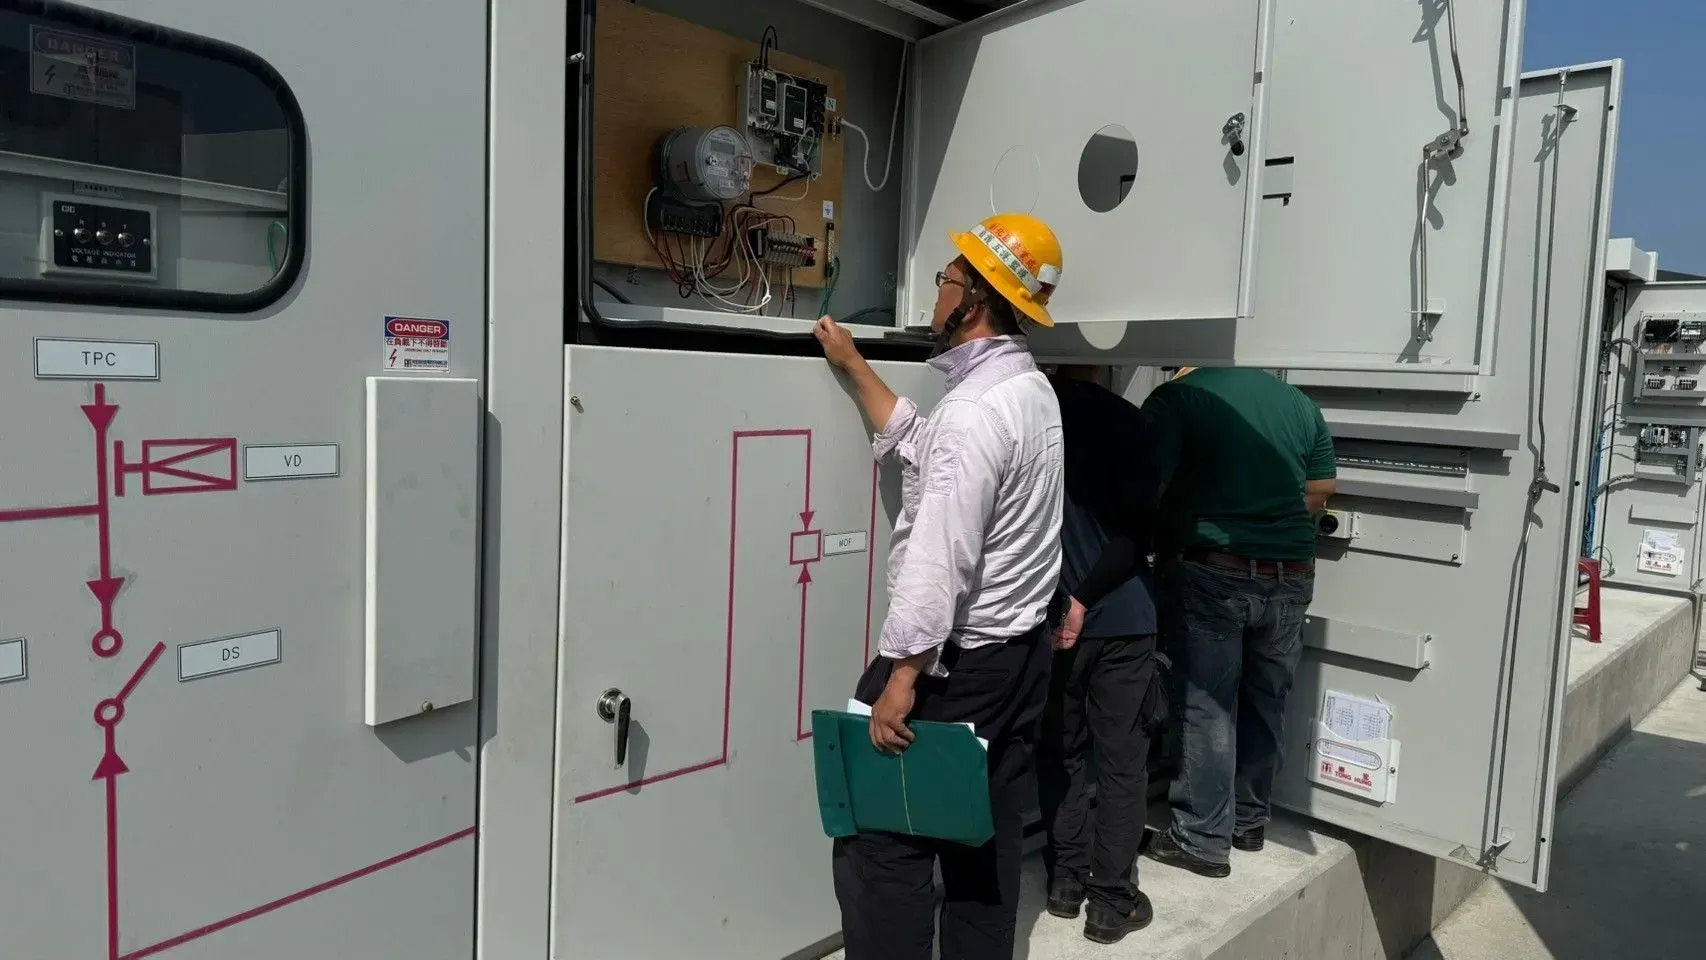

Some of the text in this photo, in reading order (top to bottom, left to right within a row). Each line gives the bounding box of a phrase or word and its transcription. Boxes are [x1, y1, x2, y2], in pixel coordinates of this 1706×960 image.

[394, 322, 441, 334] DANGER
[81, 351, 116, 366] TPC
[284, 455, 302, 467] VD
[222, 647, 240, 661] DS
[1335, 771, 1352, 781] TONG
[1354, 777, 1372, 786] HUNG
